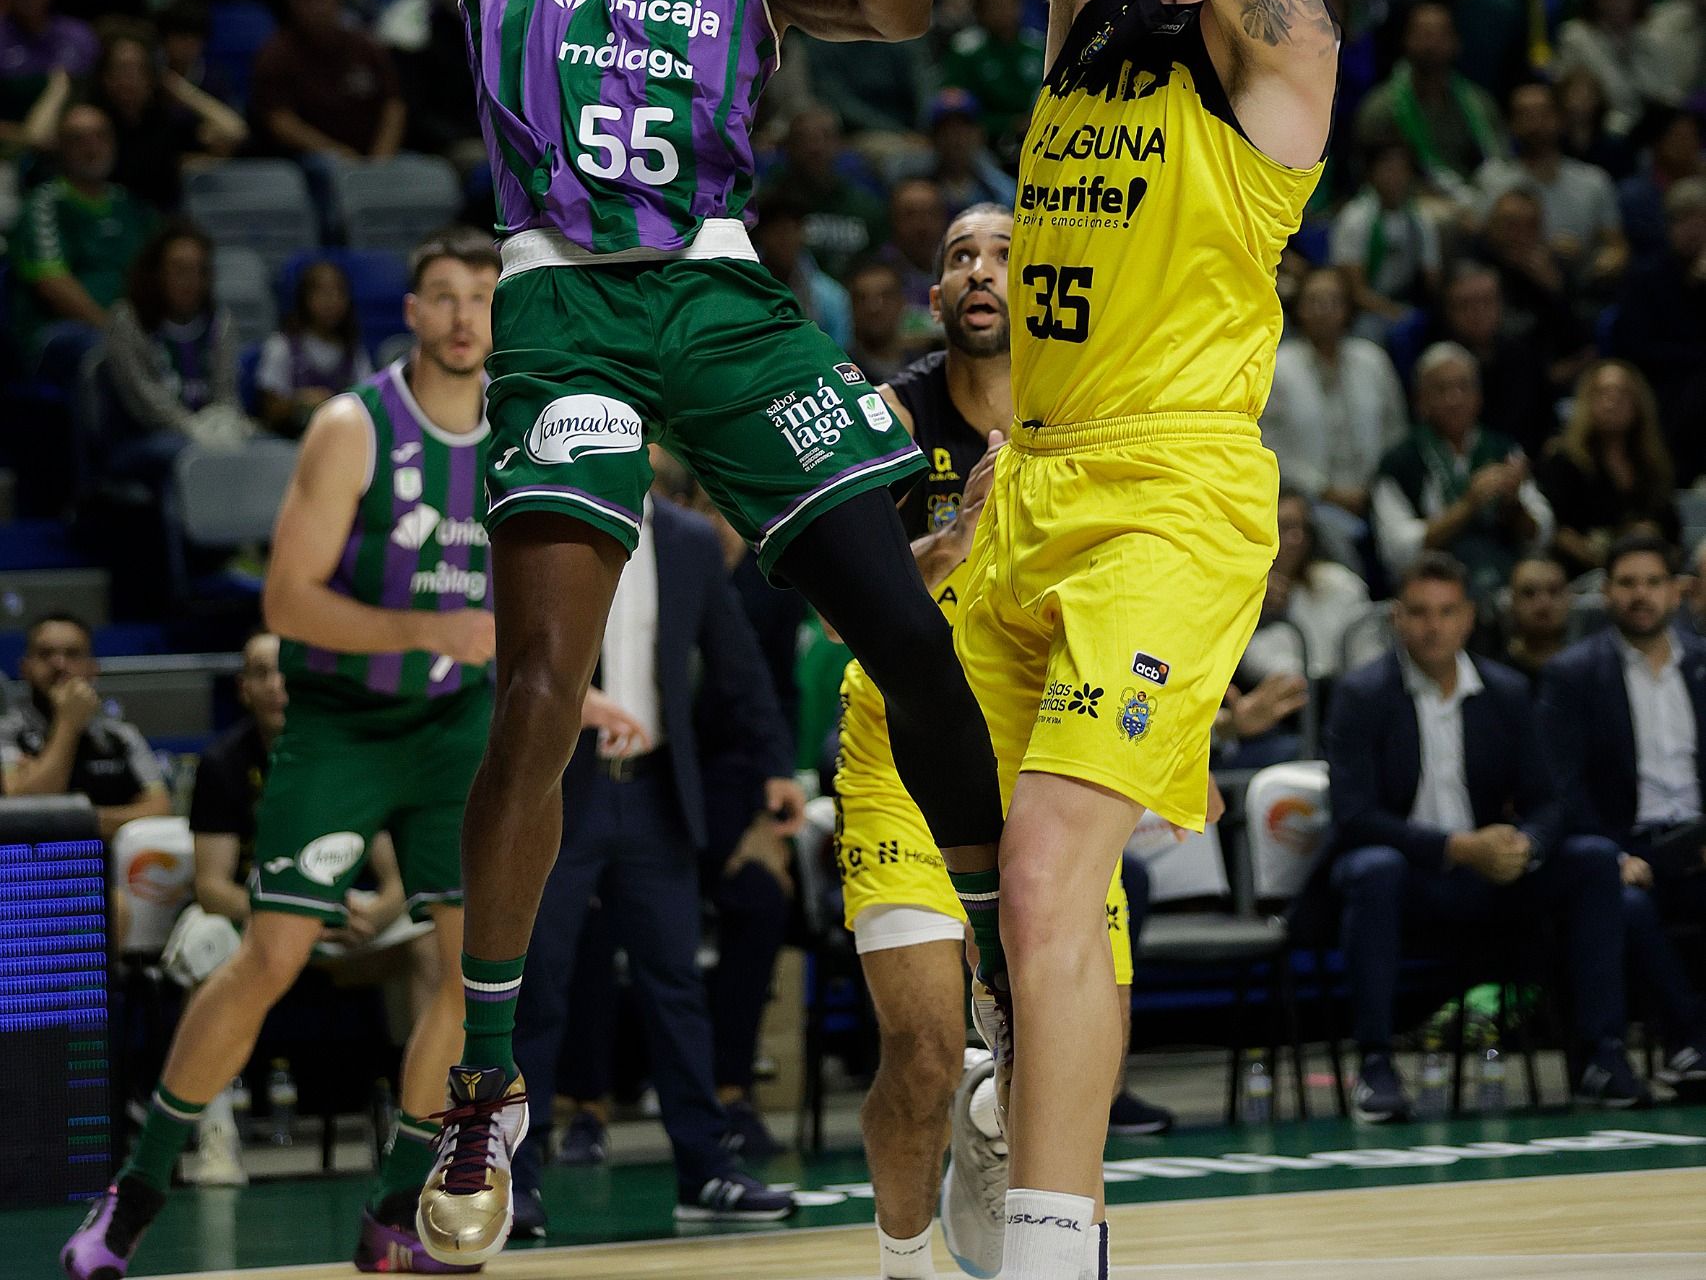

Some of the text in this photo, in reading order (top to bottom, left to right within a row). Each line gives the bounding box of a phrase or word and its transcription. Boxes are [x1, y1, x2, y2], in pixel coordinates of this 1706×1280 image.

[576, 105, 680, 186] 55
[1020, 176, 1148, 229] enerife!
[1051, 216, 1120, 229] emociones
[1022, 264, 1094, 343] 35
[534, 401, 641, 454] famadesa
[766, 390, 798, 417] sabor
[772, 415, 786, 428] a
[782, 377, 844, 430] má
[780, 407, 855, 457] laga
[1047, 680, 1073, 698] slas
[1135, 662, 1160, 681] acb
